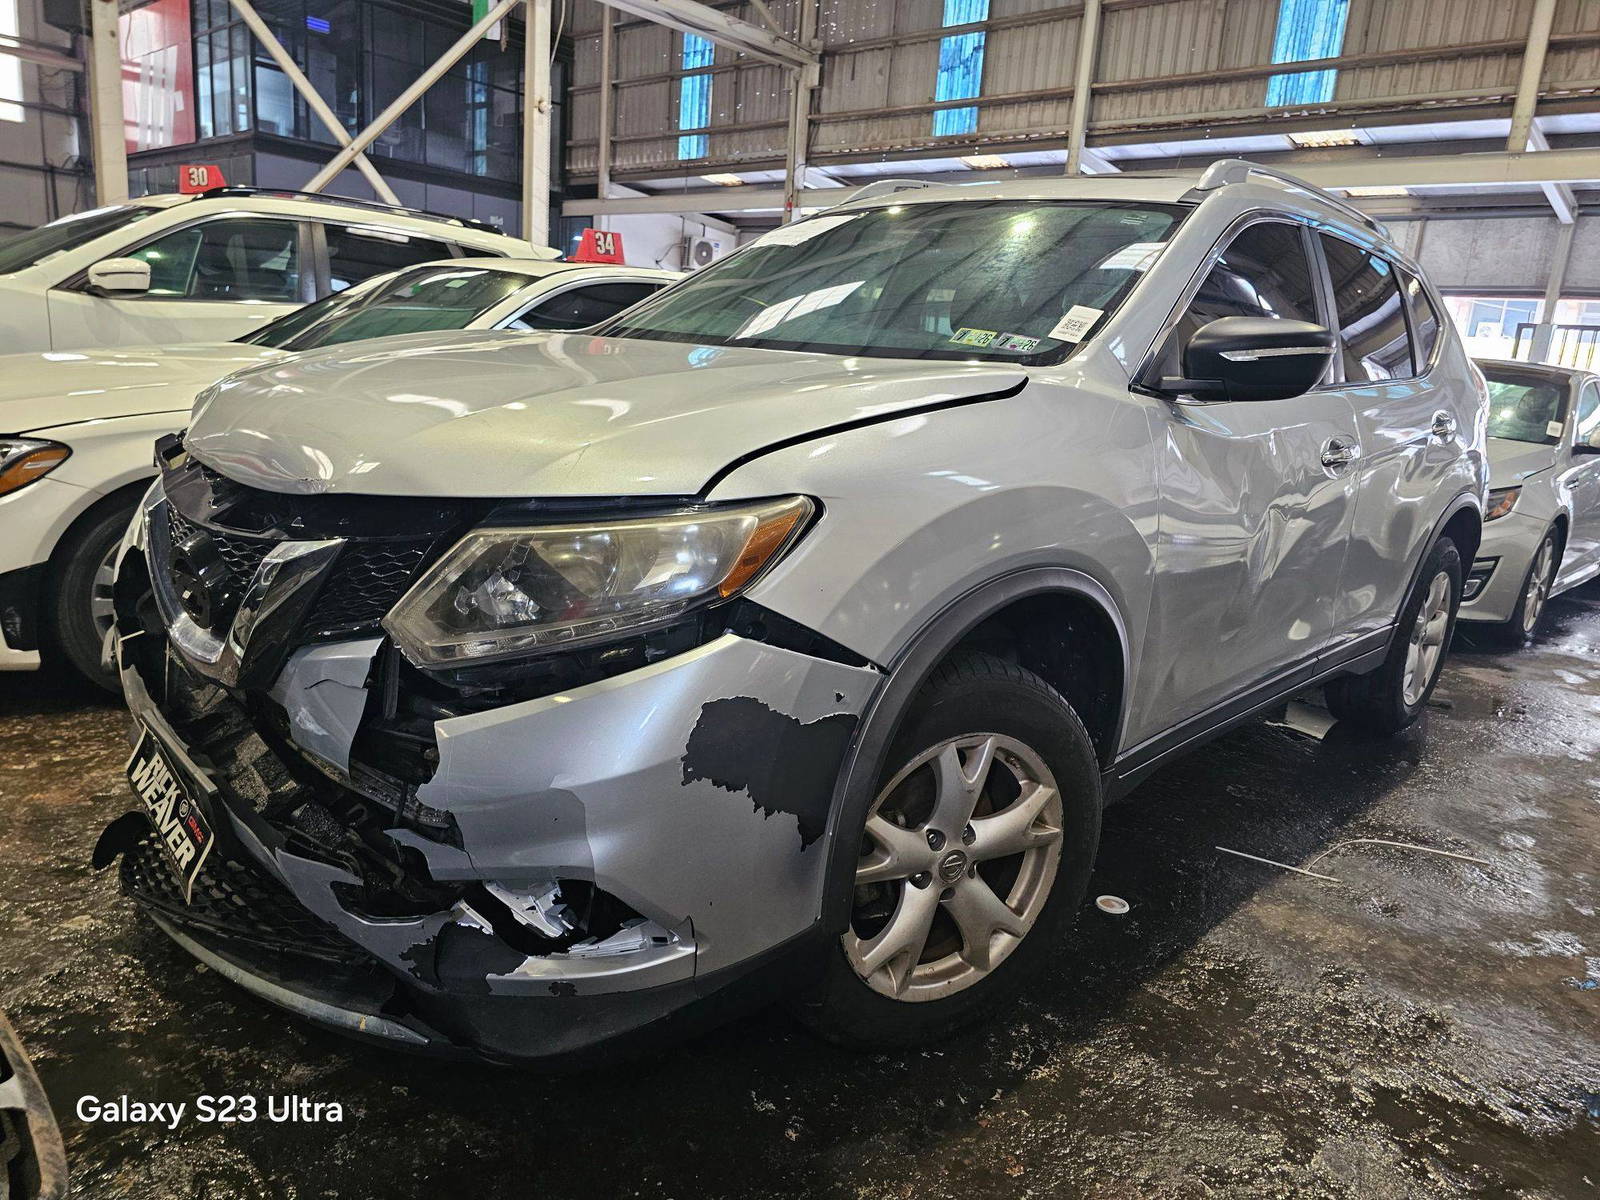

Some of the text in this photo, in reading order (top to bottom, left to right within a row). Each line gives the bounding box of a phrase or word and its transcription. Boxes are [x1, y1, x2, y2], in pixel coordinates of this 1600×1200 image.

[188, 167, 208, 187] 30
[595, 231, 615, 256] 34
[147, 752, 181, 801] RICK
[131, 757, 196, 871] WEAVER
